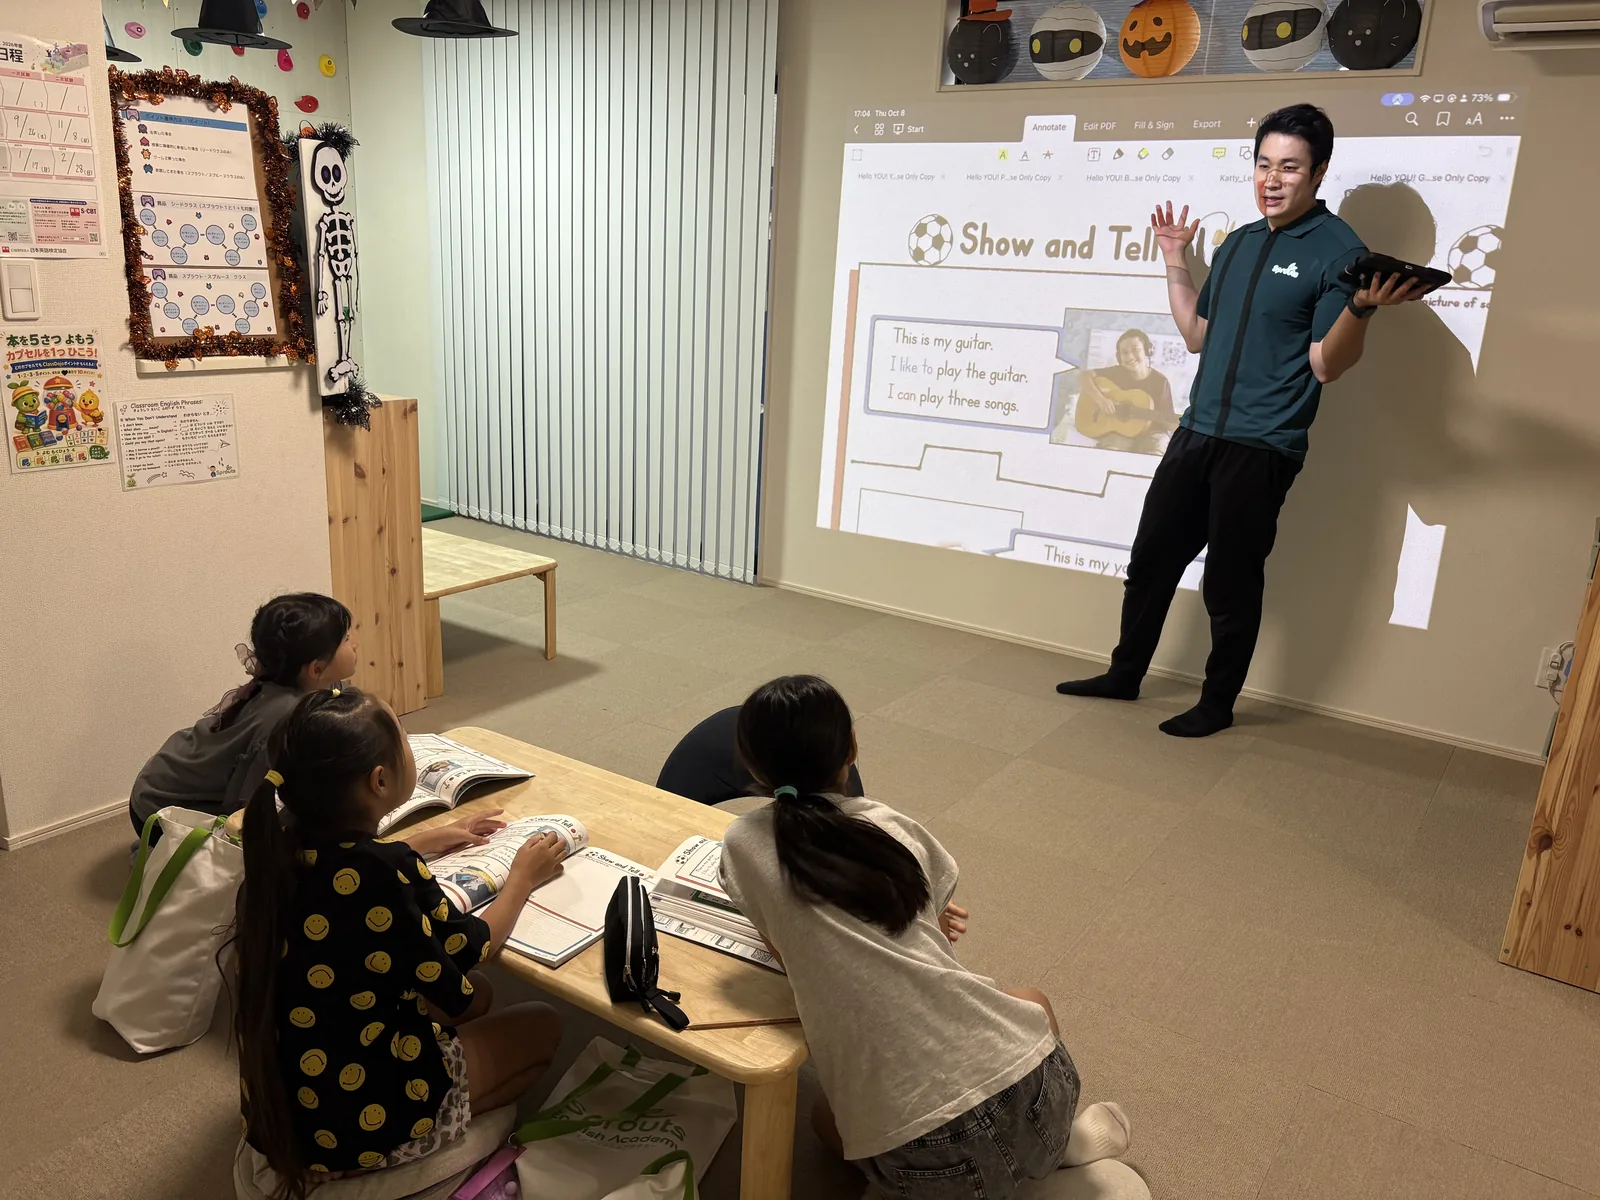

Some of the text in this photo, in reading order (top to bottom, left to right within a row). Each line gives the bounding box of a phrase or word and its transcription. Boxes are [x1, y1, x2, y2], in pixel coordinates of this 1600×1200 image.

[0, 47, 24, 63] 日程
[1471, 93, 1494, 102] 73%
[875, 109, 887, 117] Thu
[888, 109, 899, 117] Oct
[907, 125, 924, 133] Start
[1032, 123, 1067, 131] Annotate
[1083, 122, 1117, 130] Edit PDF
[1134, 121, 1174, 131] Fill & Sign
[1193, 120, 1221, 129] Export
[1019, 174, 1033, 182] Only
[1034, 174, 1051, 182] Copy
[1086, 174, 1103, 182] Hello
[1105, 174, 1123, 182] YOU!
[1145, 174, 1161, 183] Only
[1162, 174, 1181, 183] Copy
[1220, 174, 1253, 183] Katty_Le
[1370, 174, 1392, 182] Hello
[1394, 174, 1416, 182] YOU!
[1445, 174, 1465, 183] Only
[1467, 174, 1490, 183] Copy
[960, 221, 1159, 262] Show and Tell
[1464, 297, 1476, 308] of
[6, 333, 95, 348] 本を5さつ よもう
[893, 326, 994, 354] This is my guitar.
[6, 347, 66, 362] カプセルを1つ
[890, 355, 1029, 386] I like to play the guitar.
[887, 383, 1019, 415] I can play three songs.
[1044, 544, 1071, 564] This
[1075, 553, 1085, 566] is
[1089, 559, 1109, 575] my
[561, 819, 573, 828] Tell
[598, 854, 614, 863] Show
[628, 866, 641, 874] Tell
